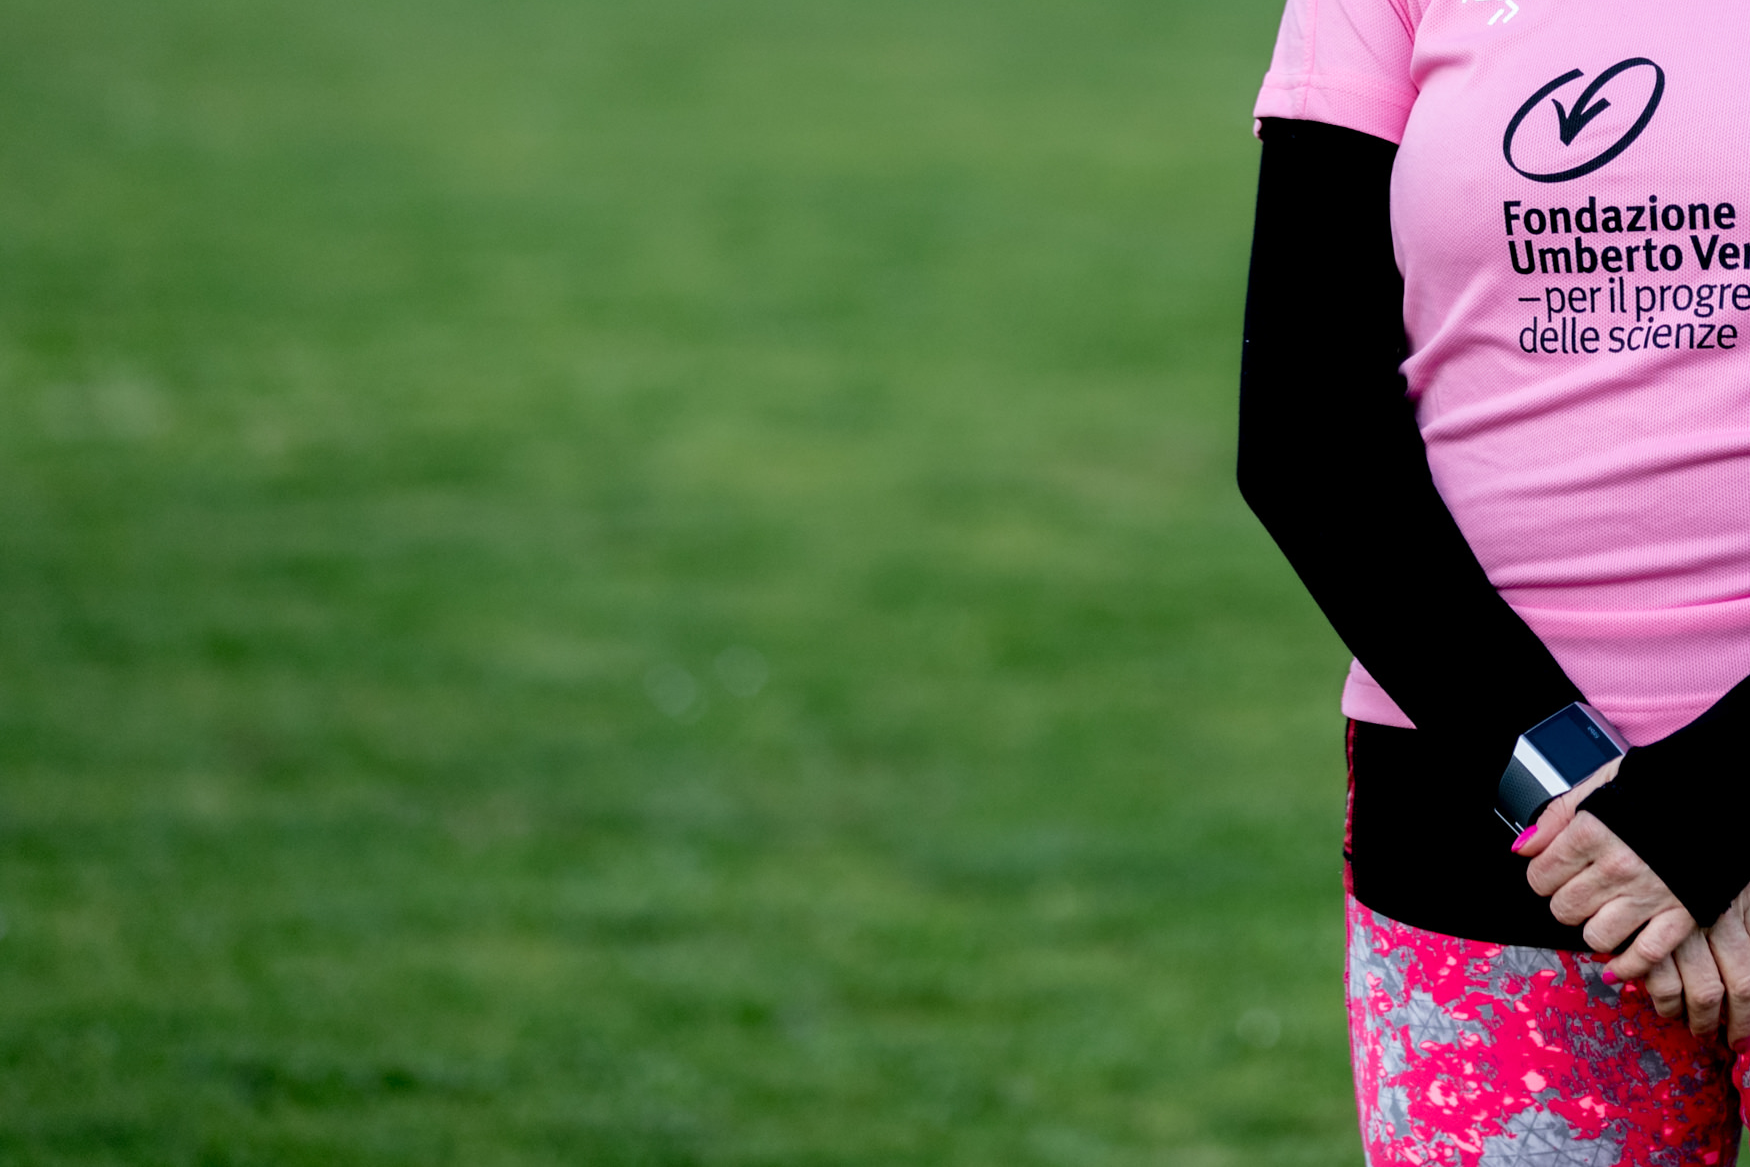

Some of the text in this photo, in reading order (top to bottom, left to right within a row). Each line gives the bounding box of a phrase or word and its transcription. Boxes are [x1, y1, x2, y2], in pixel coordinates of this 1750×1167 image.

[1503, 195, 1736, 236] Fondazione
[1508, 236, 1683, 275] Umberto
[1609, 276, 1627, 313] il
[1519, 316, 1738, 354] delle scienze
